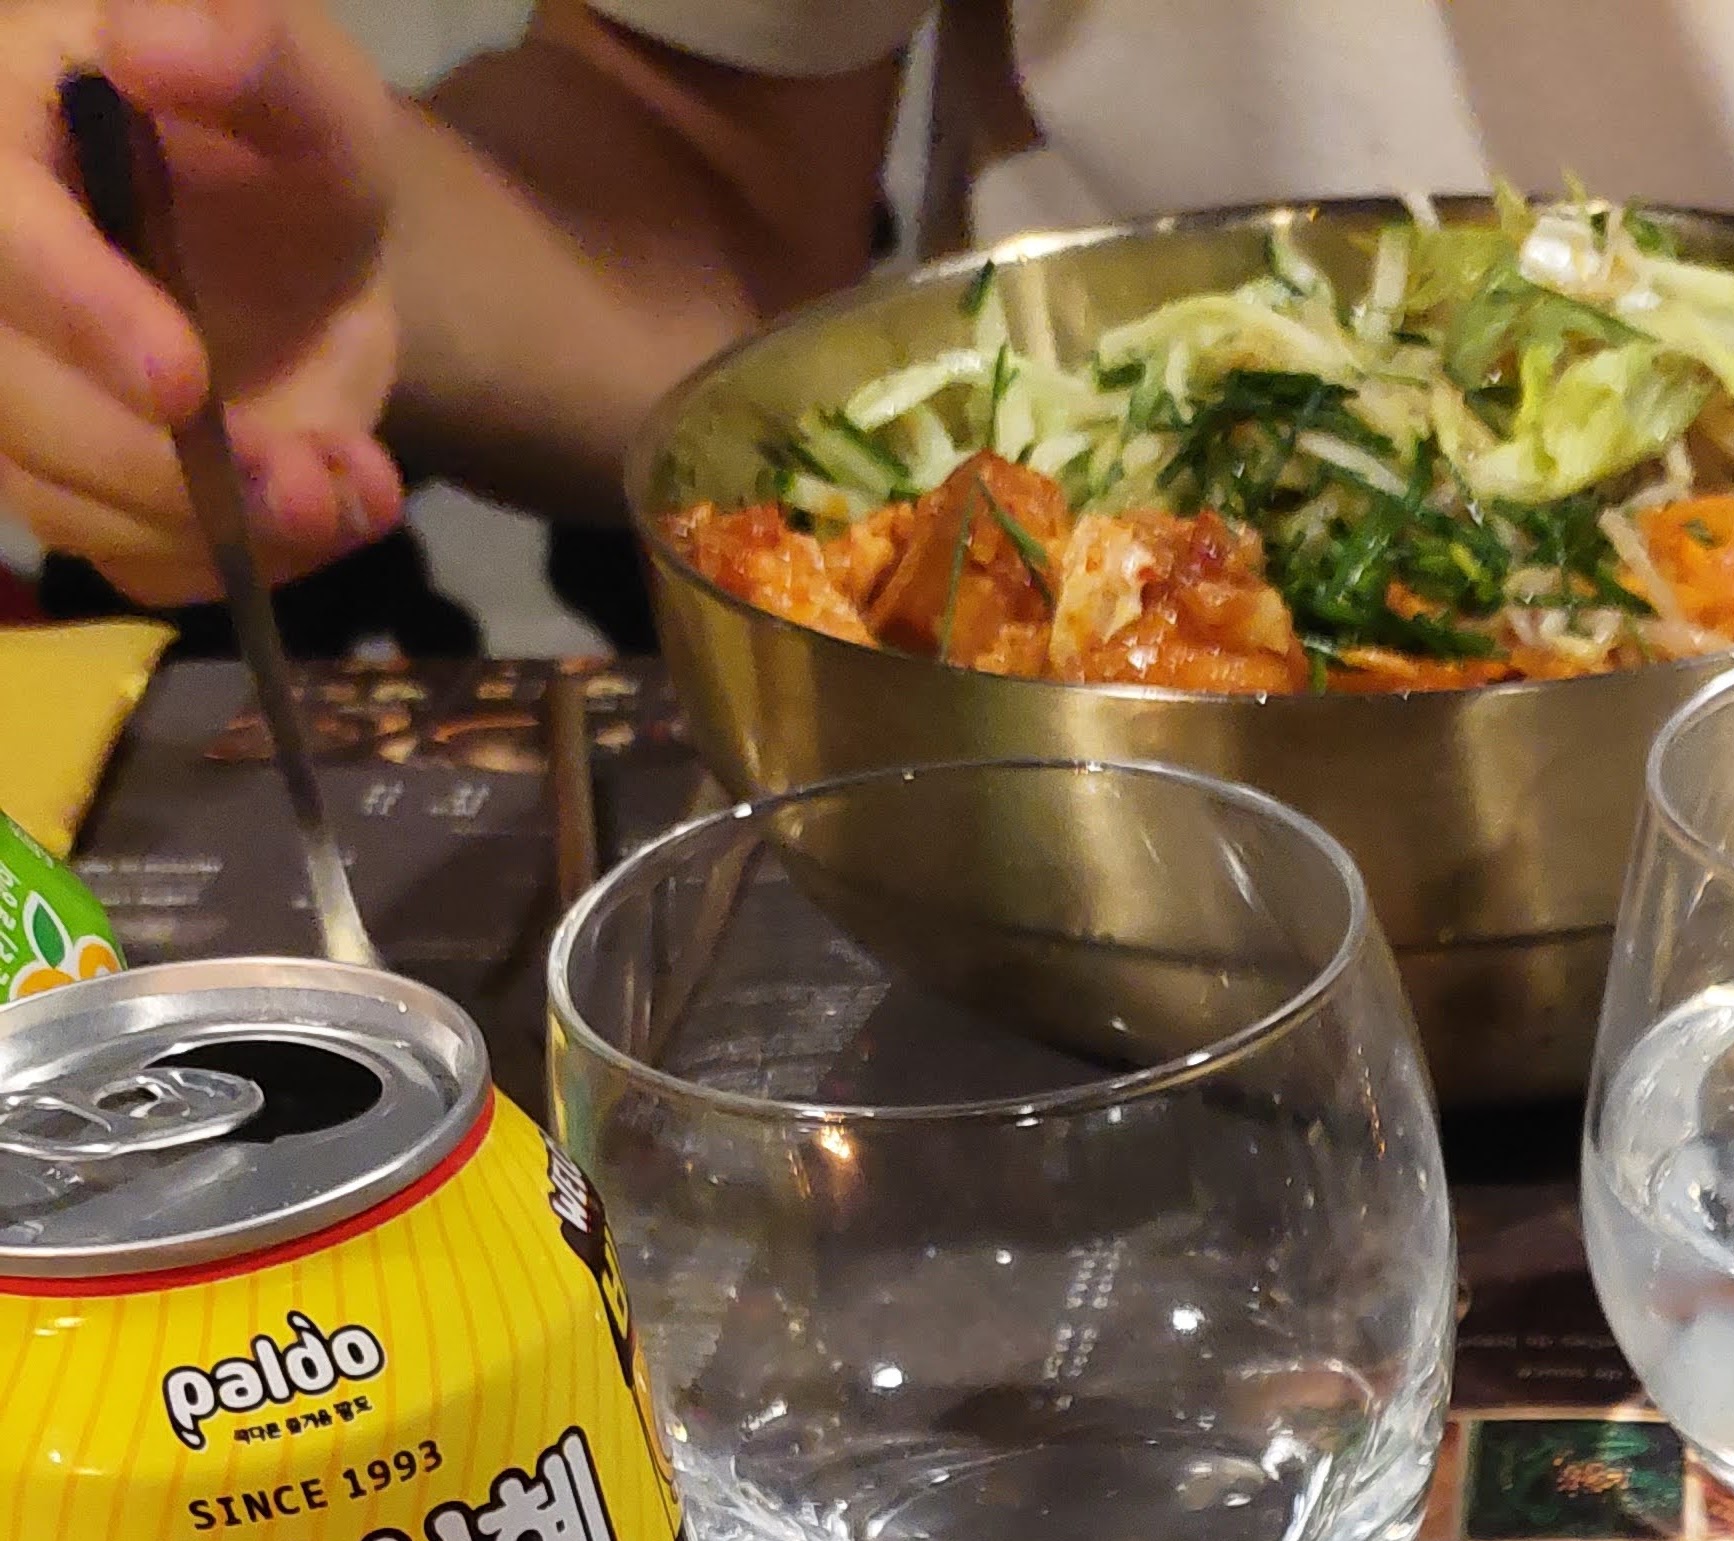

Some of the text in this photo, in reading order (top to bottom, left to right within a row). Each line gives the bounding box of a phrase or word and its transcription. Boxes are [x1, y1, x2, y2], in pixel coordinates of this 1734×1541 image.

[162, 1309, 387, 1450] paldo
[190, 1438, 445, 1531] SINCE 1993
